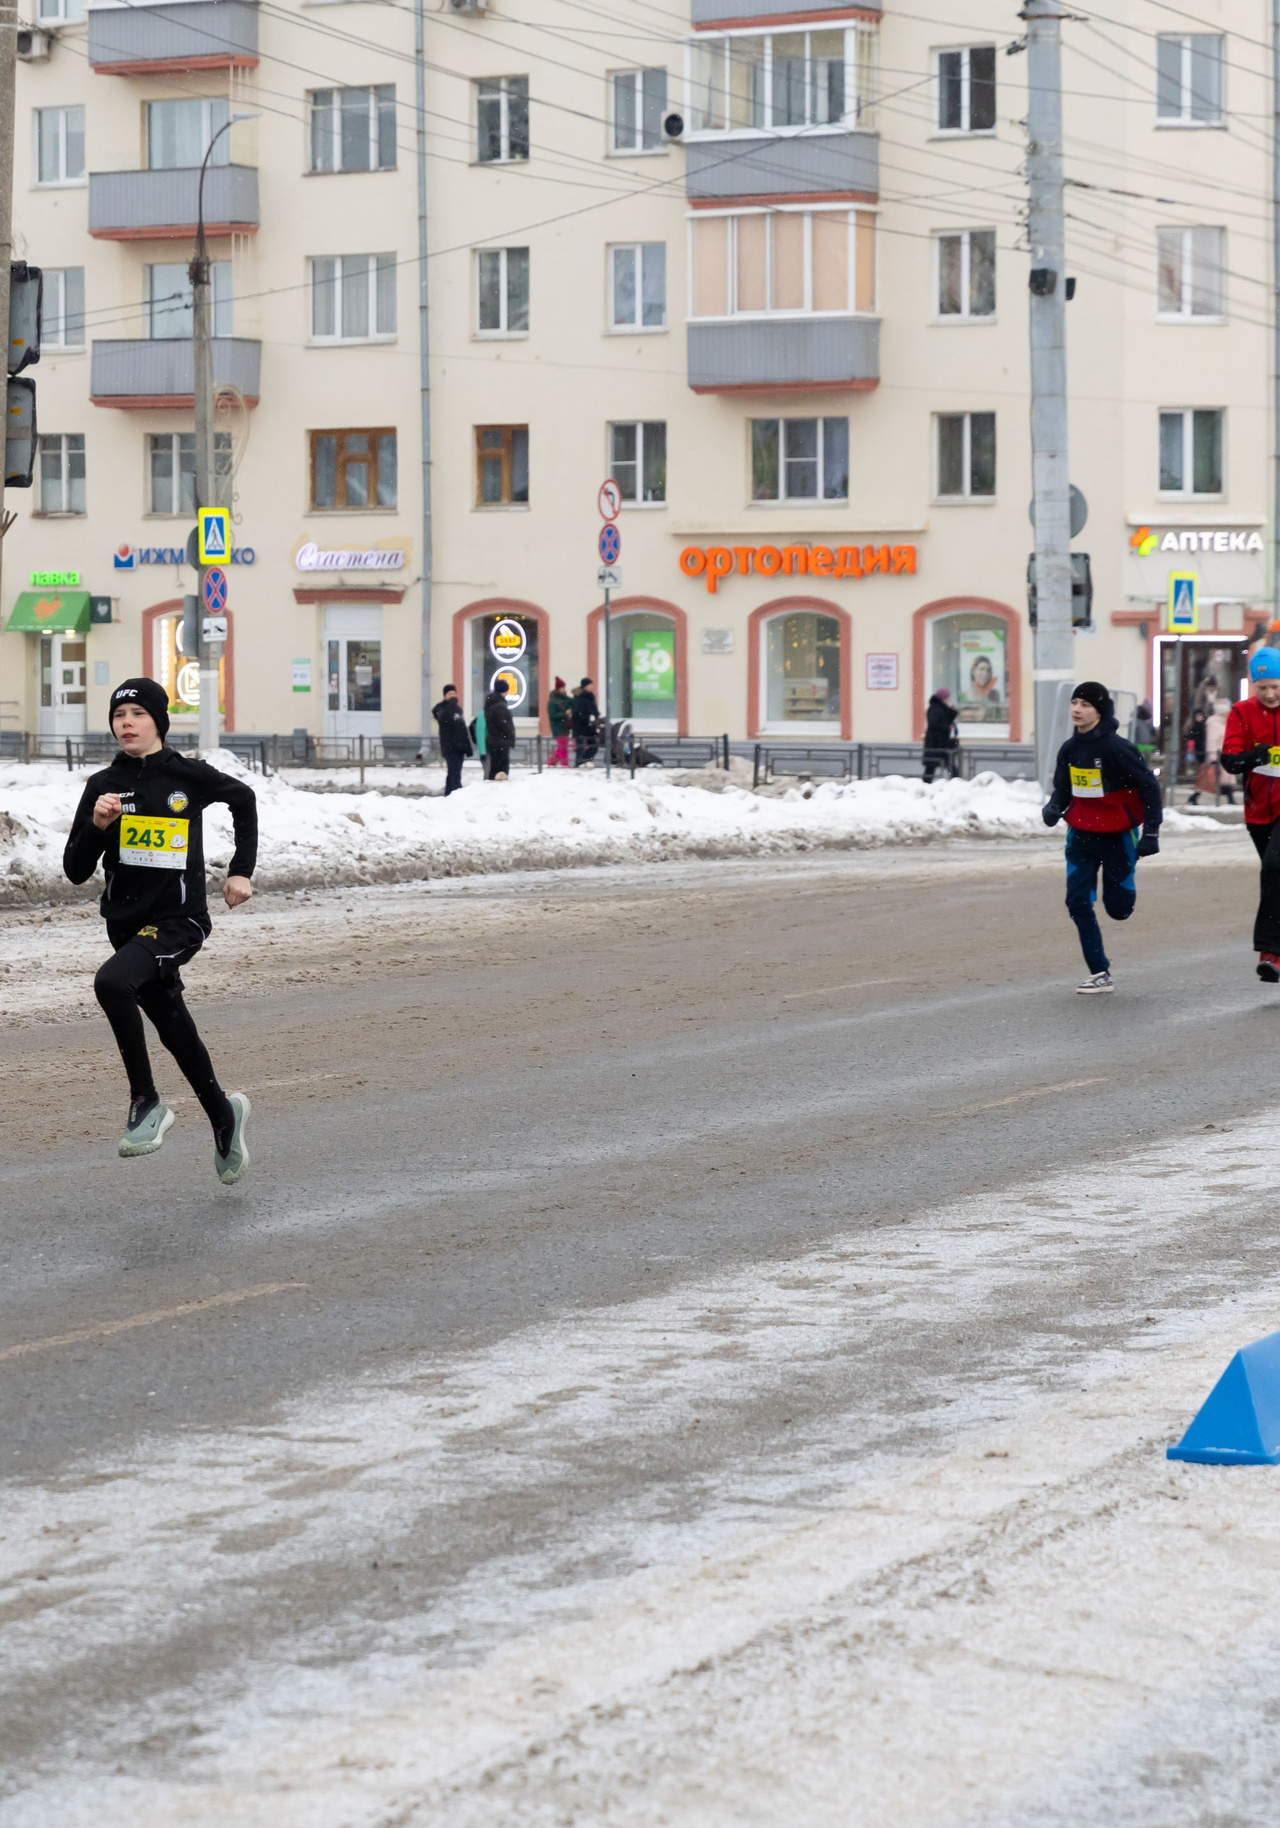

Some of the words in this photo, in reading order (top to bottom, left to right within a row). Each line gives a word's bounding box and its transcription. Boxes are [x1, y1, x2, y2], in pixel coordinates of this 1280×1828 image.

[1160, 531, 1264, 552] АПТЕКА
[139, 547, 255, 565] ИЖМКО
[679, 544, 917, 594] ортопедия
[634, 649, 671, 673] 30
[115, 689, 138, 699] UFC
[1073, 774, 1088, 787] 35
[126, 827, 166, 848] 243
